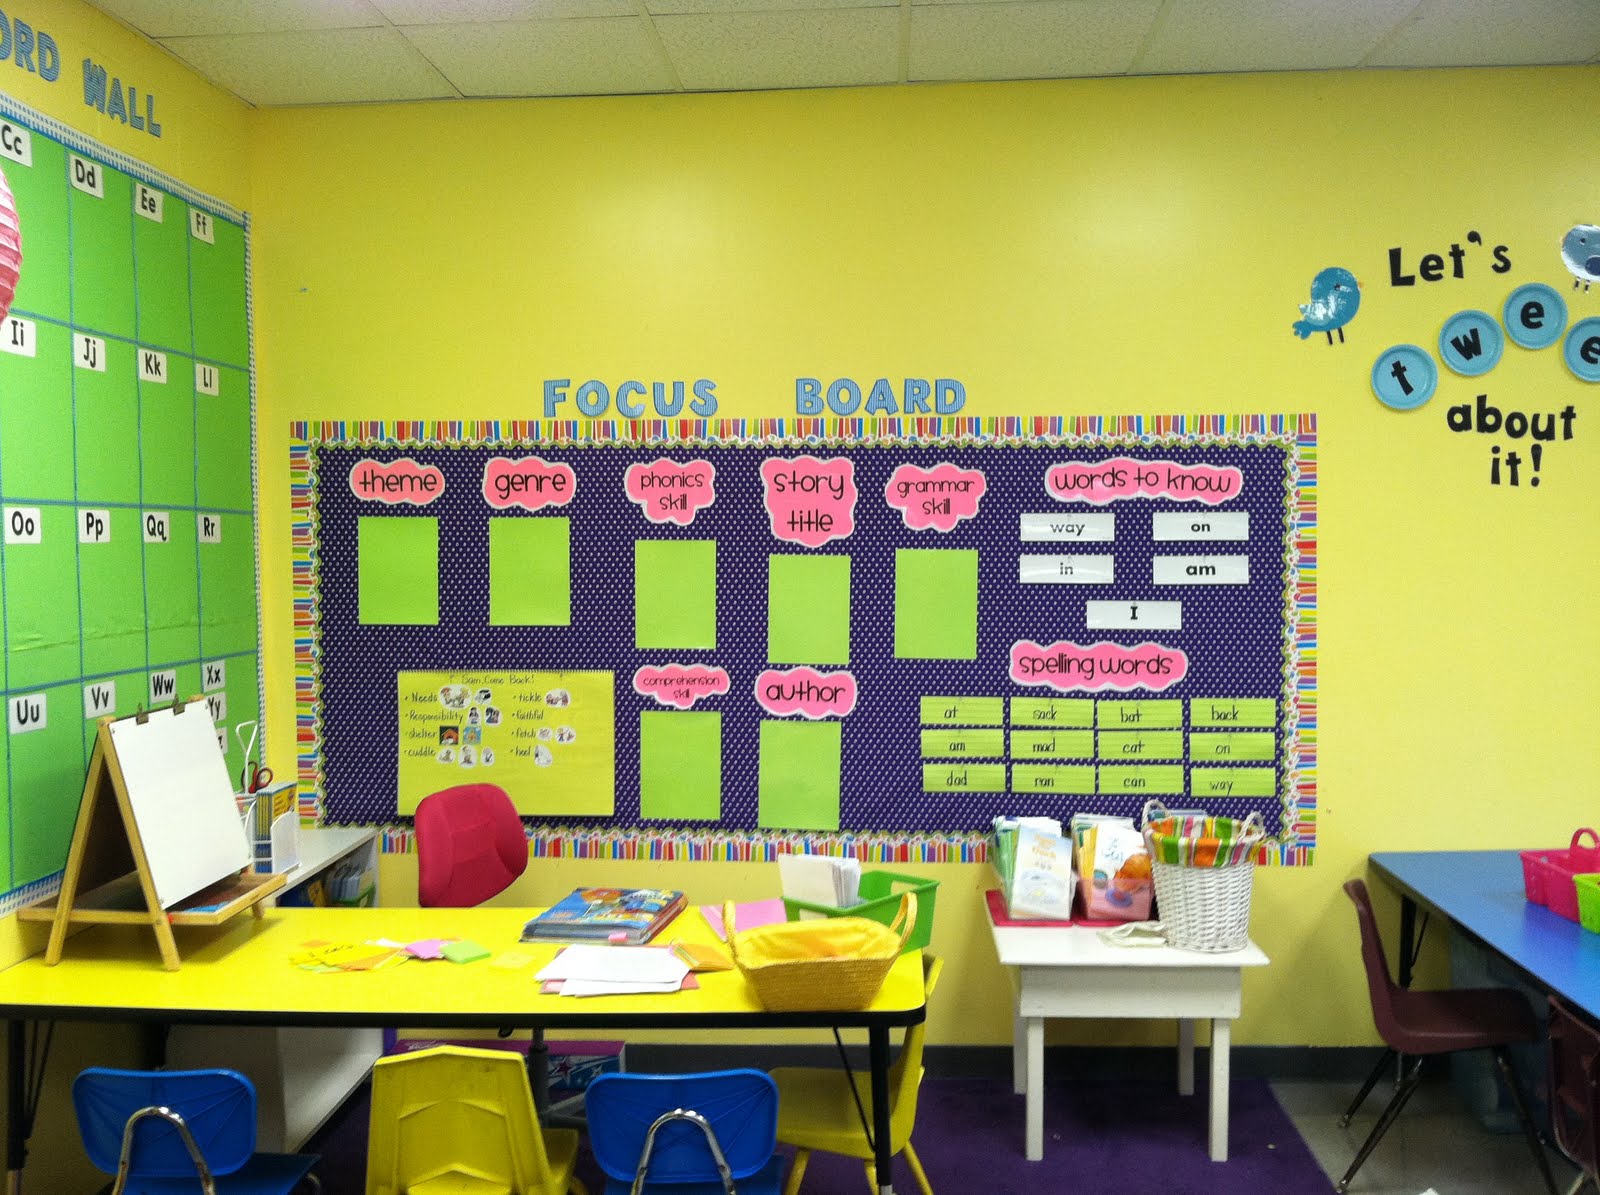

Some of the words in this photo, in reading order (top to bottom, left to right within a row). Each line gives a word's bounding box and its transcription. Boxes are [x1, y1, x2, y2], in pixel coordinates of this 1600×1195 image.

[82, 58, 162, 138] WALL
[1, 125, 22, 156] Cc
[75, 160, 96, 189] Dd
[141, 189, 156, 214] Ee
[196, 213, 207, 236] Ff
[1388, 231, 1512, 287] Let's
[11, 321, 24, 347] Ii
[83, 338, 96, 367] Jj
[145, 354, 161, 377] Kk
[203, 366, 212, 388] Ll
[543, 378, 718, 418] FOCUS
[796, 378, 966, 416] BOARD
[1447, 394, 1577, 441] about
[1490, 444, 1543, 487] it!
[359, 470, 437, 492] theme
[495, 471, 566, 500] genre
[640, 472, 704, 490] phonics
[773, 471, 844, 500] story
[897, 479, 974, 498] grammar
[1055, 468, 1127, 490] words
[1133, 467, 1159, 487] to
[1167, 468, 1230, 493] know
[659, 494, 687, 510] skill
[922, 499, 950, 515] skill
[11, 511, 35, 536] Oo
[86, 512, 103, 540] Pp
[146, 515, 166, 541] Qq
[203, 517, 215, 537] Rr
[787, 509, 833, 532] title
[1050, 522, 1085, 537] way
[1190, 522, 1211, 533] on
[1059, 562, 1074, 576] in
[1185, 565, 1216, 576] am
[1130, 606, 1138, 620] I
[207, 665, 221, 685] Xx
[1019, 653, 1095, 680] spelling
[1100, 654, 1173, 674] words
[152, 674, 174, 697] Ww
[643, 676, 720, 687] comprehension
[766, 680, 846, 703] author
[91, 686, 109, 710] Vv
[412, 692, 438, 702] Needs
[519, 693, 542, 702] tickle
[673, 688, 690, 699] skill
[17, 700, 40, 725] Uu
[208, 696, 221, 720] Yy
[944, 707, 958, 719] at
[1033, 706, 1057, 721] sack
[1120, 707, 1143, 722] bat
[1211, 705, 1240, 721] back
[949, 740, 966, 752] am
[1122, 741, 1145, 753] cat
[1215, 743, 1231, 754] on
[946, 771, 967, 787] dad
[1123, 776, 1146, 788] can
[1209, 779, 1233, 795] way
